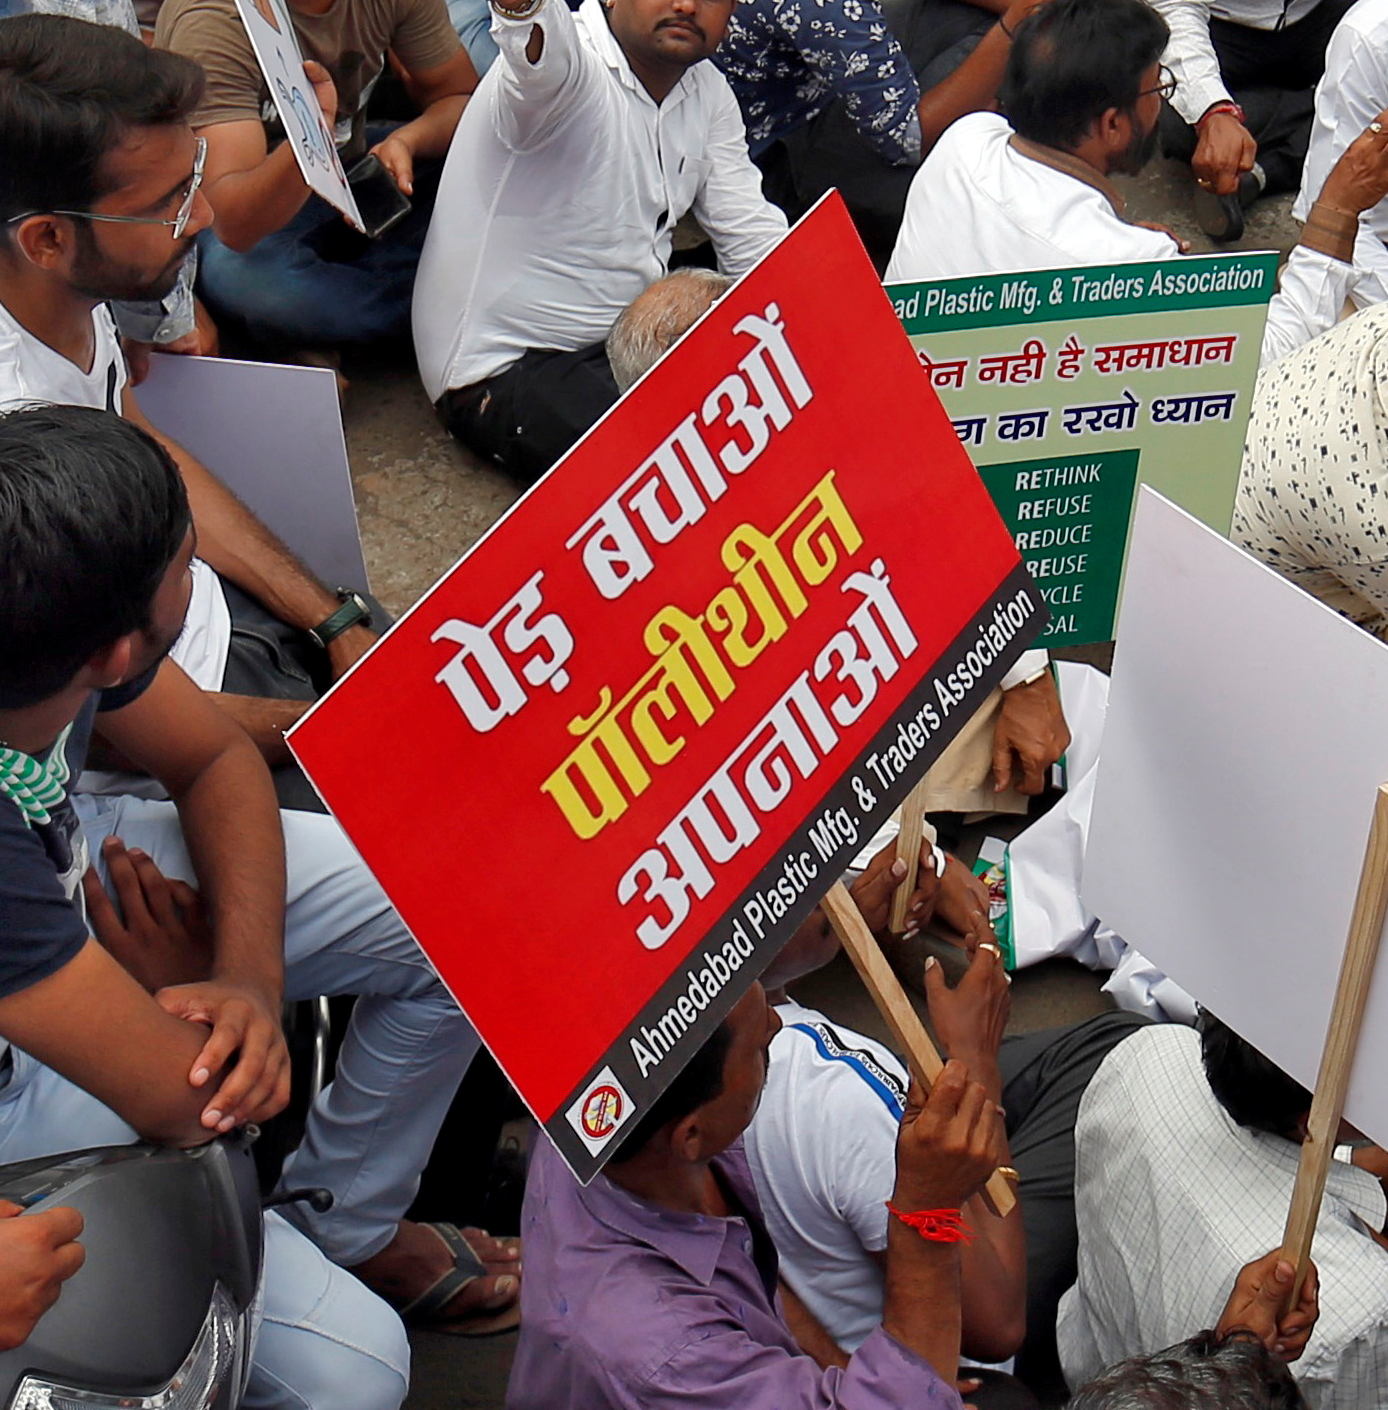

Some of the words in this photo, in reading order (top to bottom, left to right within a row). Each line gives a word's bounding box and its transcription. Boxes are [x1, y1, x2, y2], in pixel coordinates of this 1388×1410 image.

[1015, 463, 1102, 491] RETHINK
[1018, 494, 1092, 520] REFUSE
[1012, 524, 1092, 552] REDUCE
[630, 918, 755, 1077] Ahmedabad
[744, 852, 818, 939] Plastic
[809, 807, 860, 862] Mfg.
[852, 776, 877, 811] &
[866, 703, 941, 789] Traders
[934, 589, 1035, 716] Association
